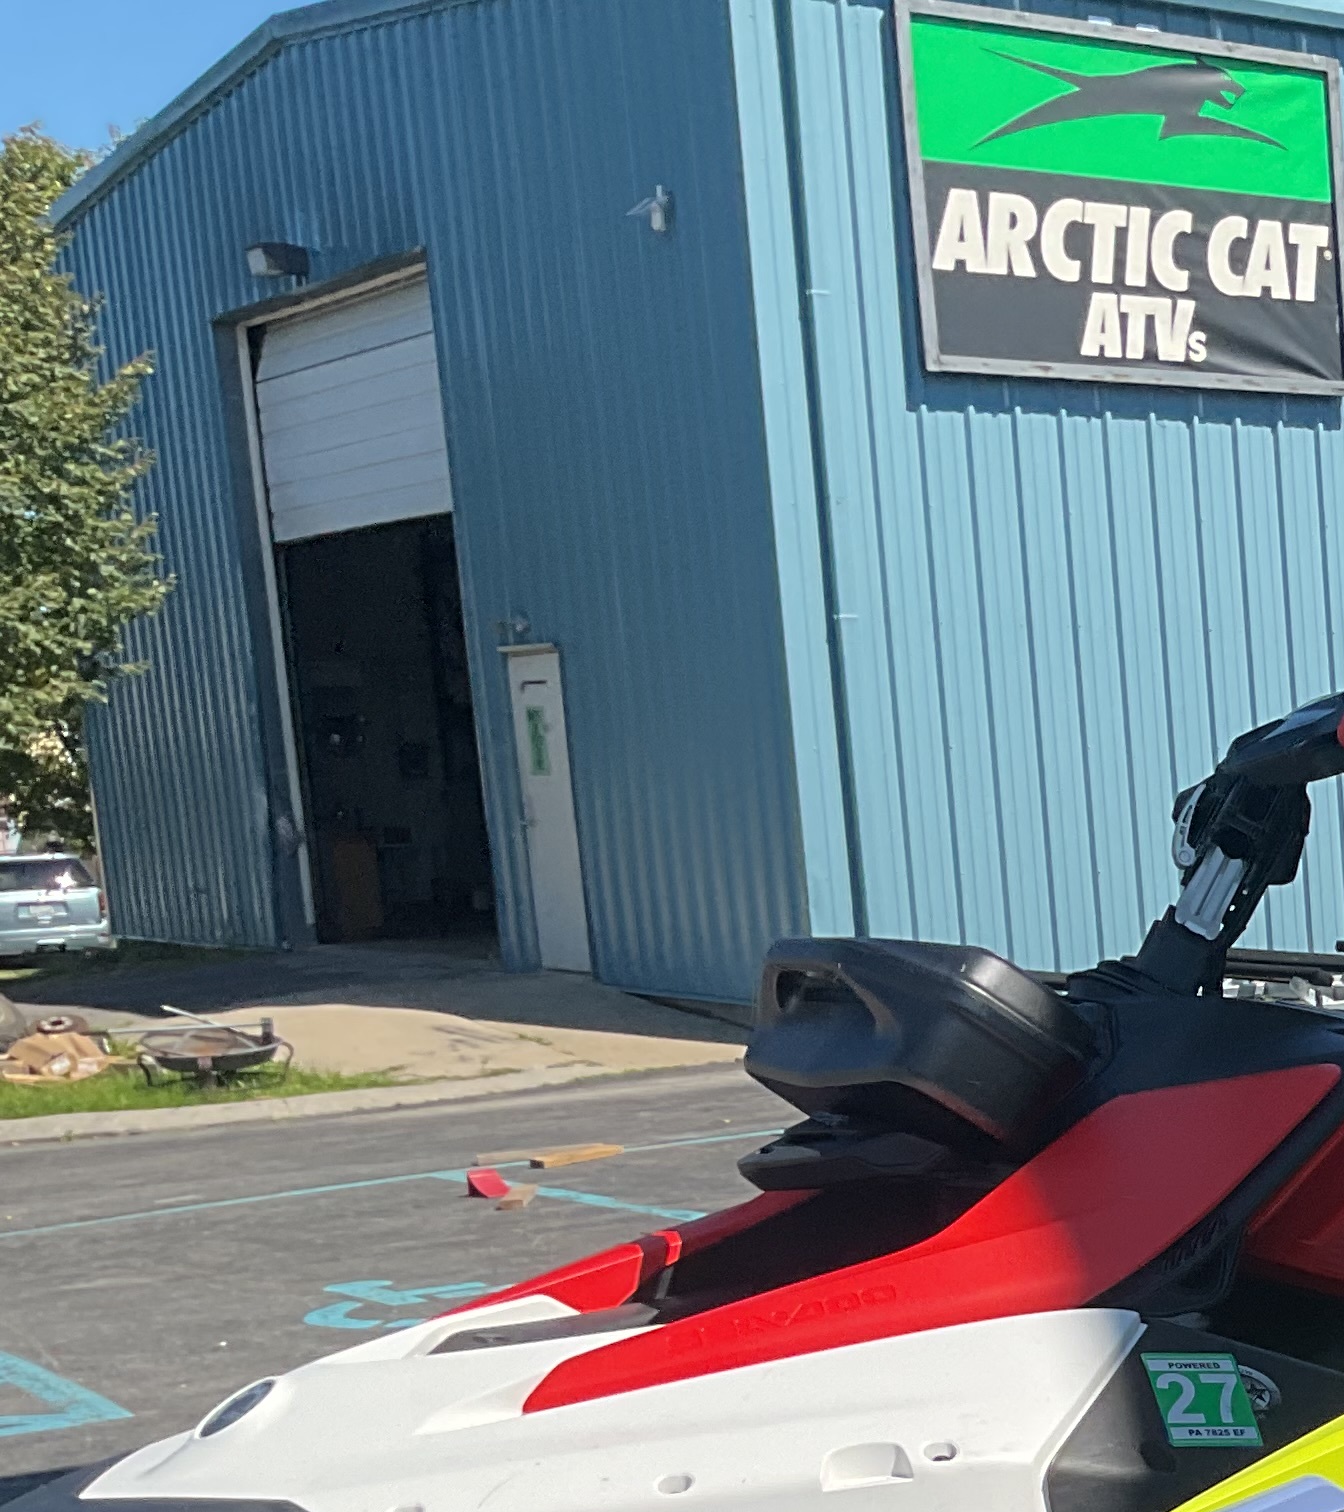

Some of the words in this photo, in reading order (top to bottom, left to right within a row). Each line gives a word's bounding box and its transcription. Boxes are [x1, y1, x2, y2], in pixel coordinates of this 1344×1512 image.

[932, 187, 1194, 292] ARCTIC
[1207, 215, 1330, 302] CAT
[1080, 292, 1207, 363] ATVs
[1156, 1373, 1238, 1423] 27
[1188, 1429, 1203, 1437] PA
